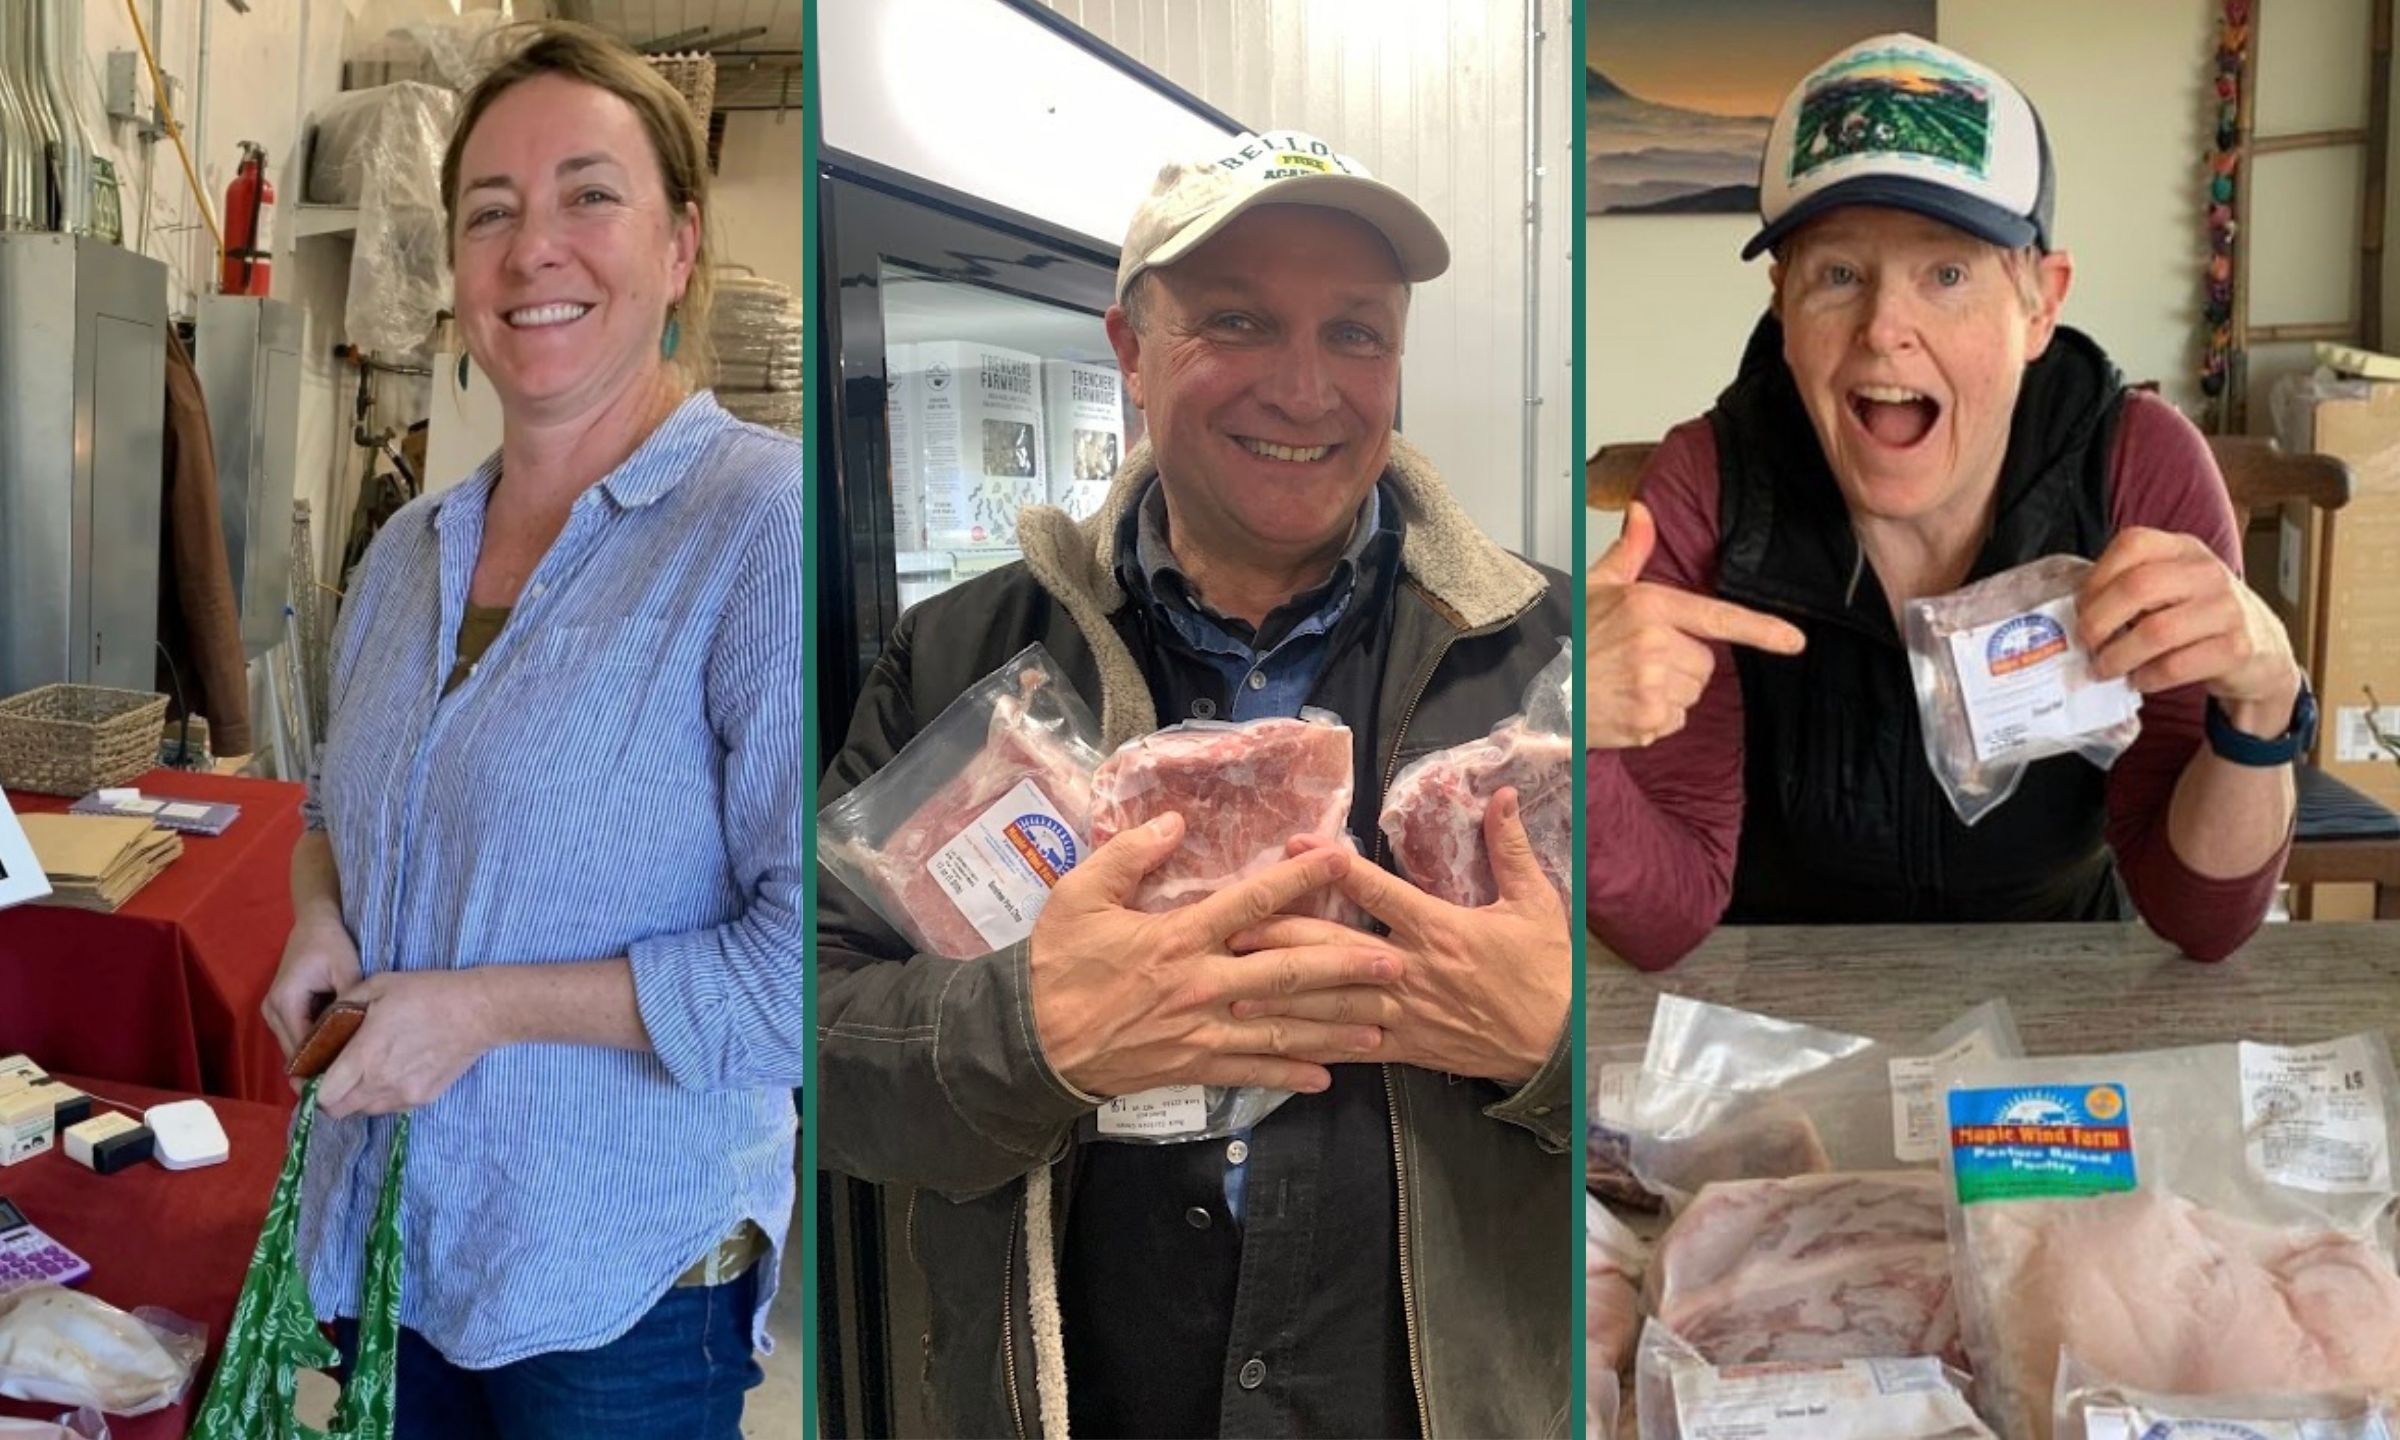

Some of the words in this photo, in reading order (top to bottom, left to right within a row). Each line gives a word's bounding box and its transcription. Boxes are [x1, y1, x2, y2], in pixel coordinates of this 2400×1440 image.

[1282, 155, 1326, 171] FREE
[1959, 1128, 2015, 1144] Maple
[2019, 1129, 2067, 1143] Wind
[2073, 1130, 2120, 1147] Farm
